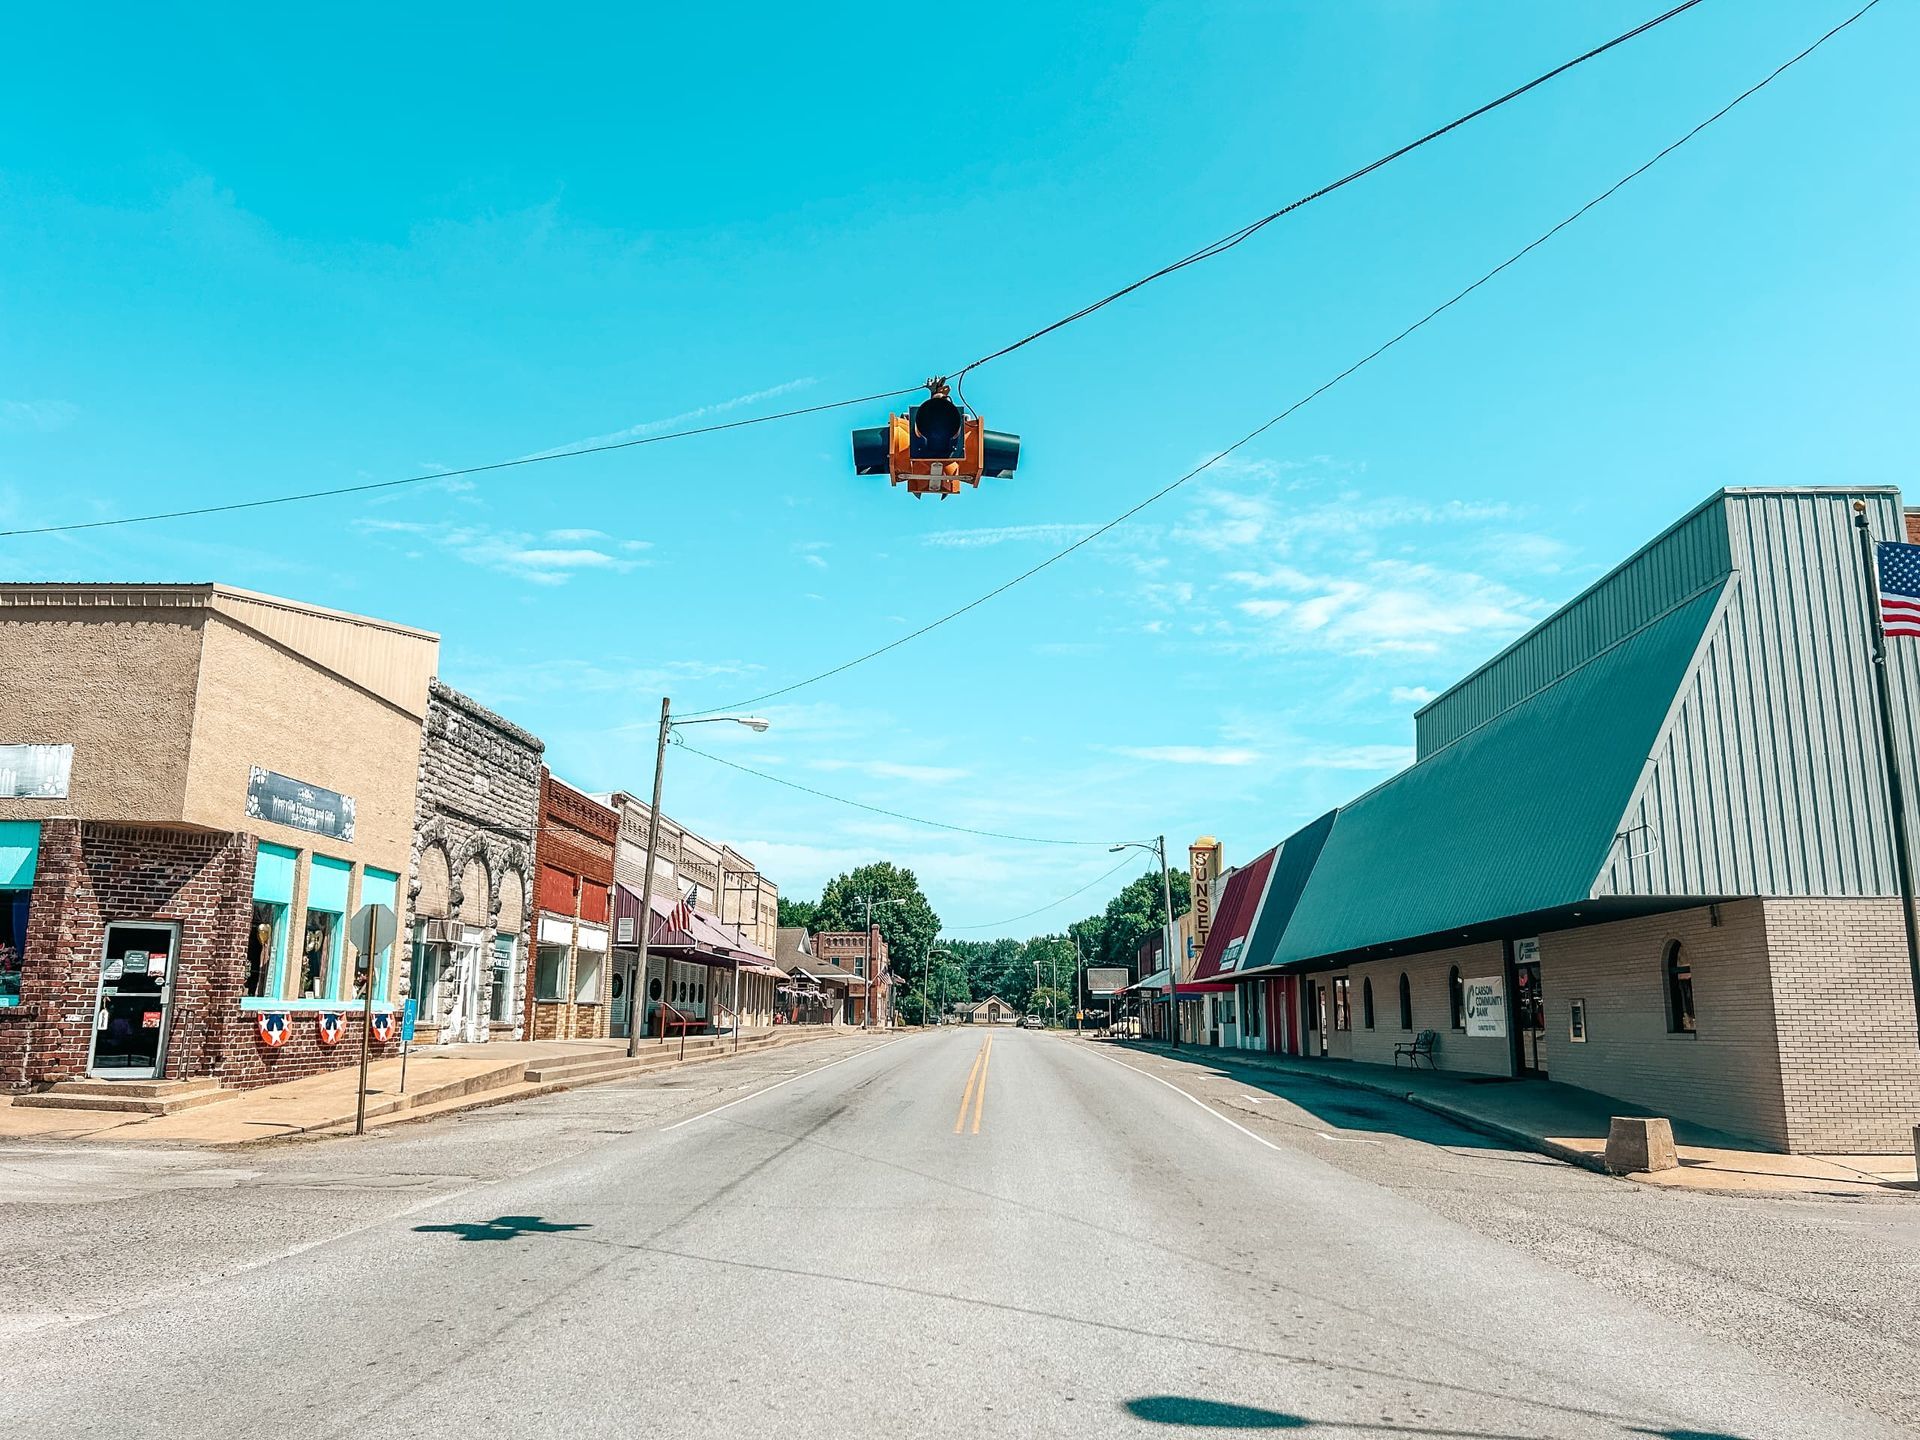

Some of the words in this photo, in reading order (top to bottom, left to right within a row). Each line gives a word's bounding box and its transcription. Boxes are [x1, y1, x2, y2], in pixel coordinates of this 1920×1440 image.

[1195, 852, 1209, 944] SUNSET
[1475, 985, 1492, 995] CARSON
[1475, 996, 1502, 1006] COMMUNITY
[1476, 1007, 1488, 1016] BANK
